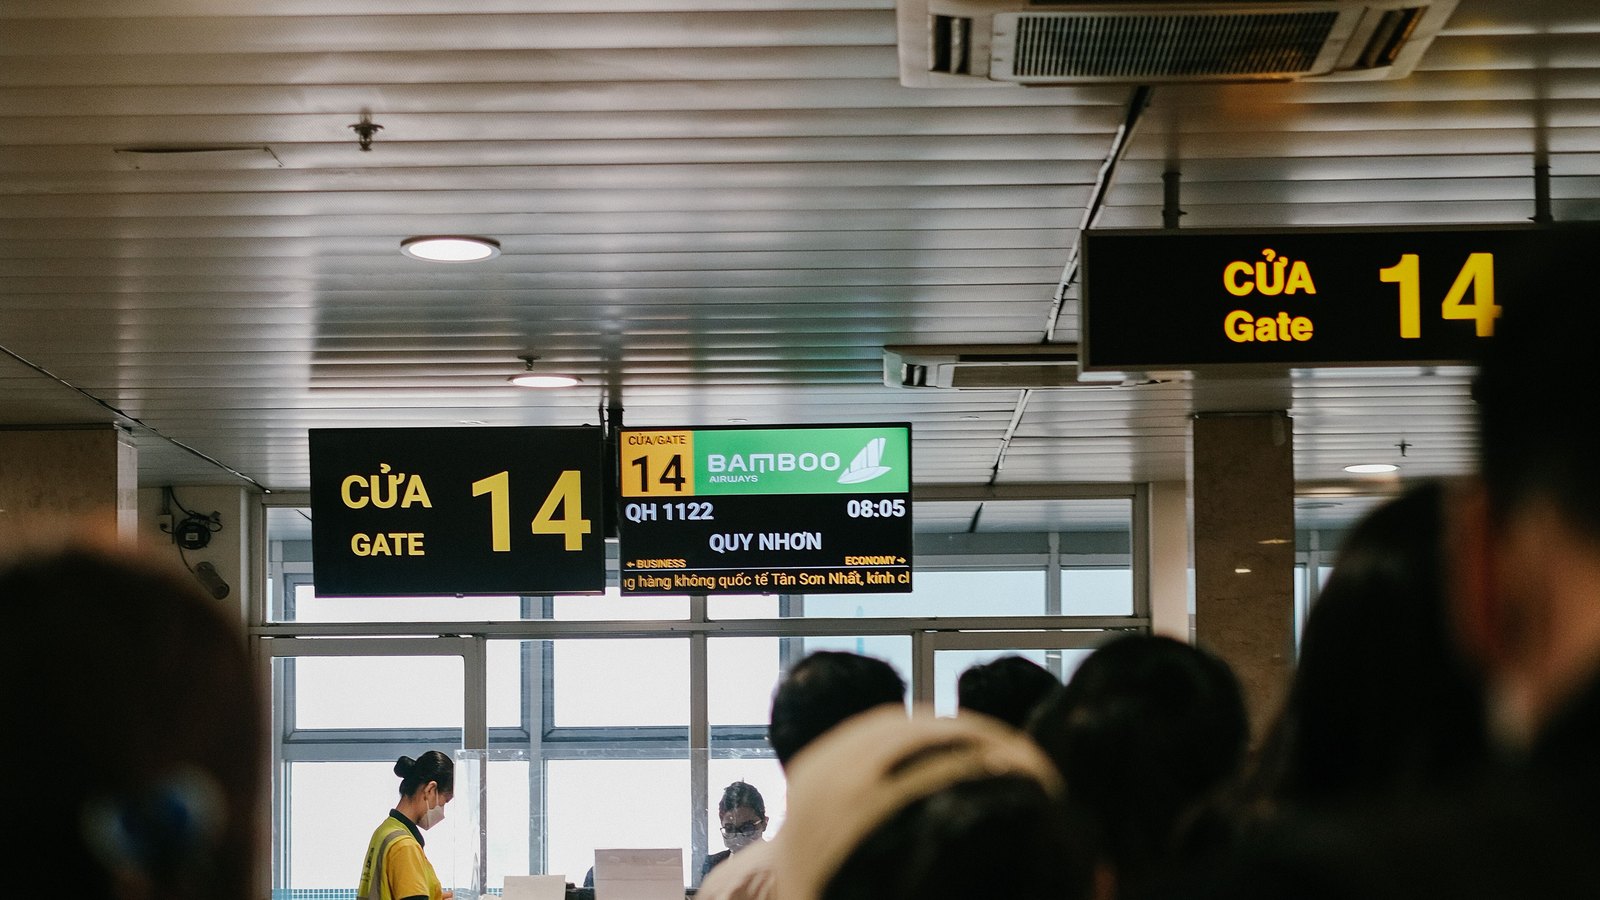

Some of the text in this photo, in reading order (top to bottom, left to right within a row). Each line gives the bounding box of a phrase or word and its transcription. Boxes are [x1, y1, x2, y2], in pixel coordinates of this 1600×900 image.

[1223, 248, 1316, 297] CỬA
[1379, 252, 1503, 339] 14
[1224, 309, 1314, 343] Gate
[629, 433, 687, 446] CỬA/GATE
[632, 454, 686, 493] 14
[707, 452, 841, 474] BAMBOO
[340, 462, 433, 509] CỬA
[708, 475, 759, 484] AIRWAYS
[472, 470, 592, 552] 14
[625, 501, 715, 523] QH 1122
[846, 499, 907, 519] 08:05
[350, 532, 425, 557] GATE
[708, 530, 822, 554] QUY NHƠN
[635, 558, 687, 569] BUSINESS
[844, 555, 897, 566] ECONOMY
[637, 574, 672, 591] hàng
[674, 573, 716, 590] không
[718, 571, 752, 589] quốc
[754, 571, 770, 586] tế
[771, 572, 797, 586] Tân
[799, 572, 826, 586] Sơn
[828, 569, 865, 587] Nhất,
[866, 571, 896, 584] kính
